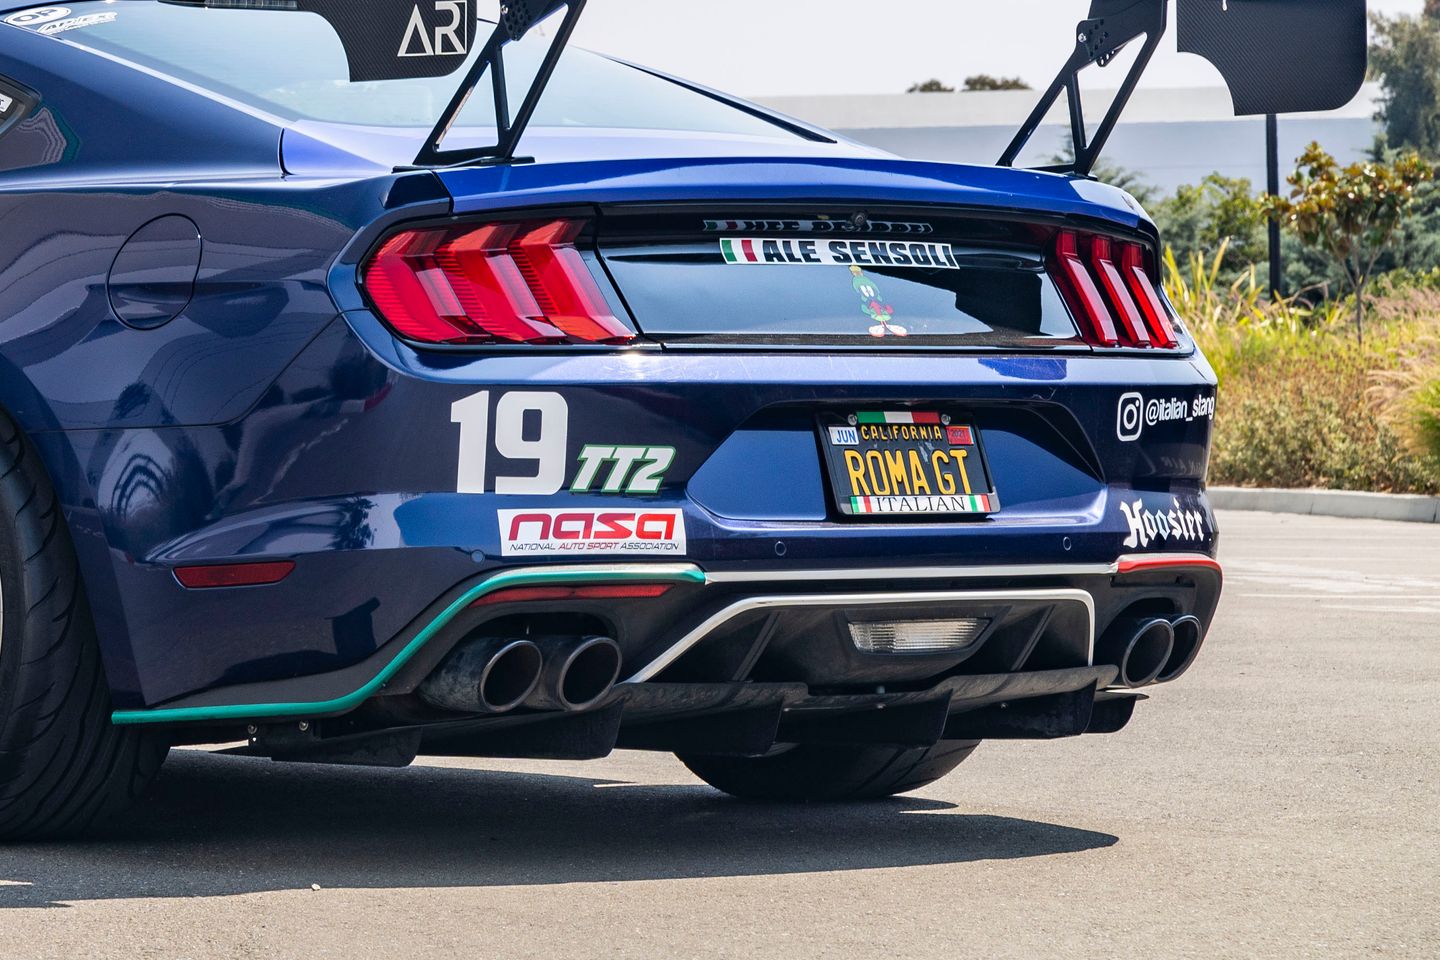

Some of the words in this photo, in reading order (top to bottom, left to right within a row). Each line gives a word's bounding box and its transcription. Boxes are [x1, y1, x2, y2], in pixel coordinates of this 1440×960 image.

[397, 0, 467, 56] AR
[763, 240, 821, 263] ALE
[828, 241, 955, 267] SENSOLI
[1145, 394, 1215, 426] @italian_stang
[450, 390, 568, 495] 19
[836, 430, 857, 444] JUN
[861, 425, 943, 440] CALIFORNIA
[569, 444, 676, 493] TT2
[844, 449, 931, 495] ROMA
[931, 449, 972, 495] GT
[876, 496, 966, 512] ITALIAN
[1120, 498, 1205, 548] Hoosier
[509, 542, 556, 551] NATIONAL
[558, 542, 585, 550] AUTO
[586, 542, 620, 550] SPORT
[620, 542, 680, 551] ASSOCIATION
